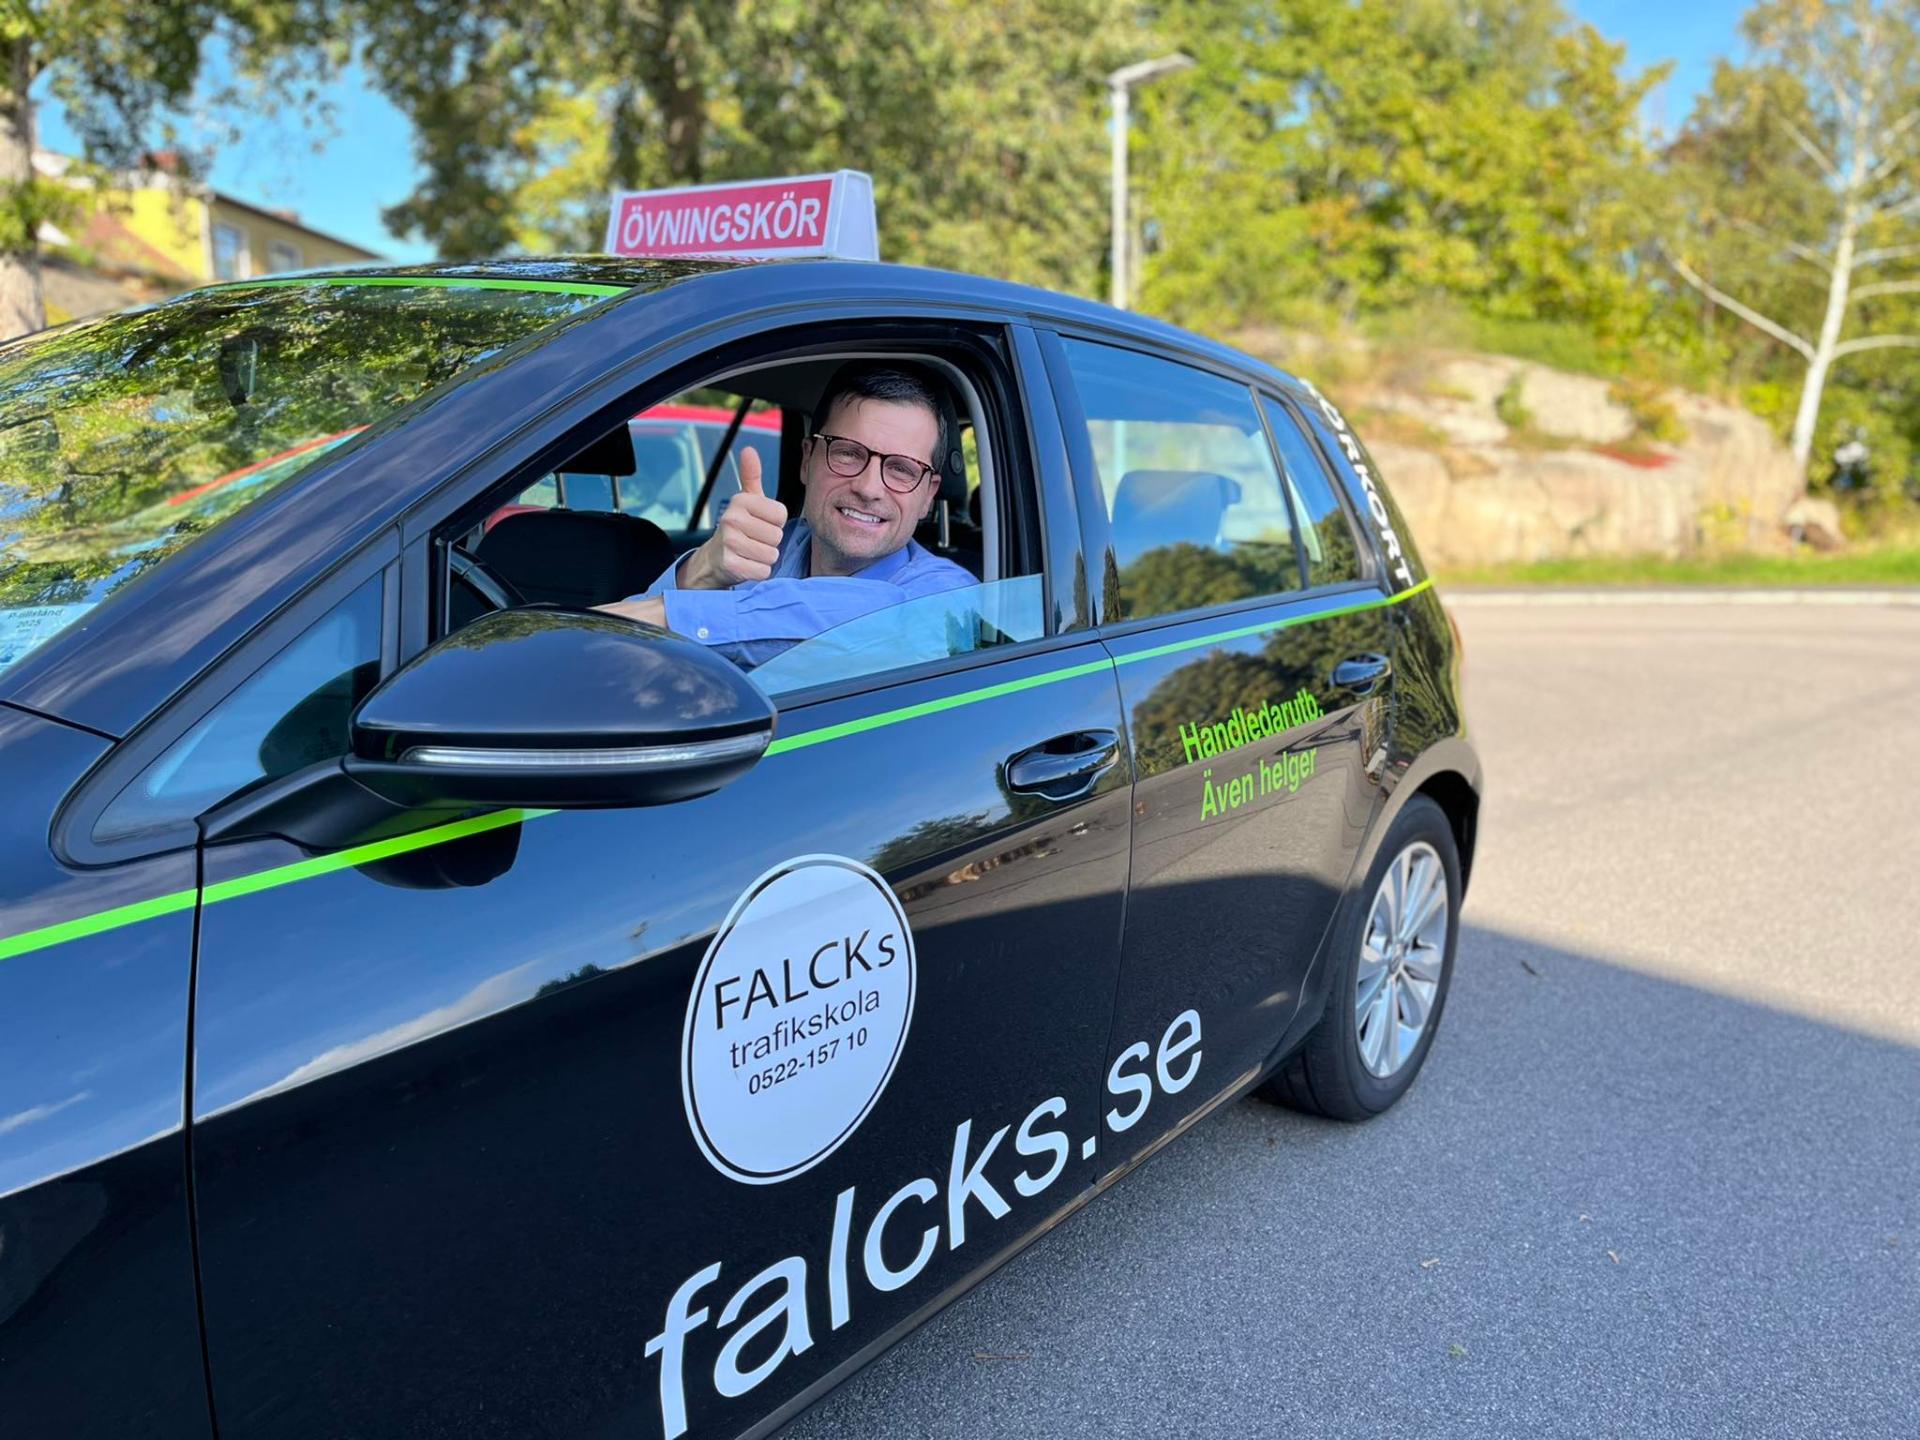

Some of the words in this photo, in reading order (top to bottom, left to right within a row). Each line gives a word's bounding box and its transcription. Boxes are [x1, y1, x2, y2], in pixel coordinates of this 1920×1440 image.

[623, 191, 821, 248] ÖVNINGSKÖR
[1178, 687, 1325, 764] Handledarutb.
[1200, 768, 1255, 822] Även
[1259, 747, 1318, 794] helger
[730, 989, 880, 1069] trafikskola
[748, 1038, 840, 1095] 0522-157
[846, 1027, 868, 1052] 10
[644, 1008, 1203, 1440] falcks.se
